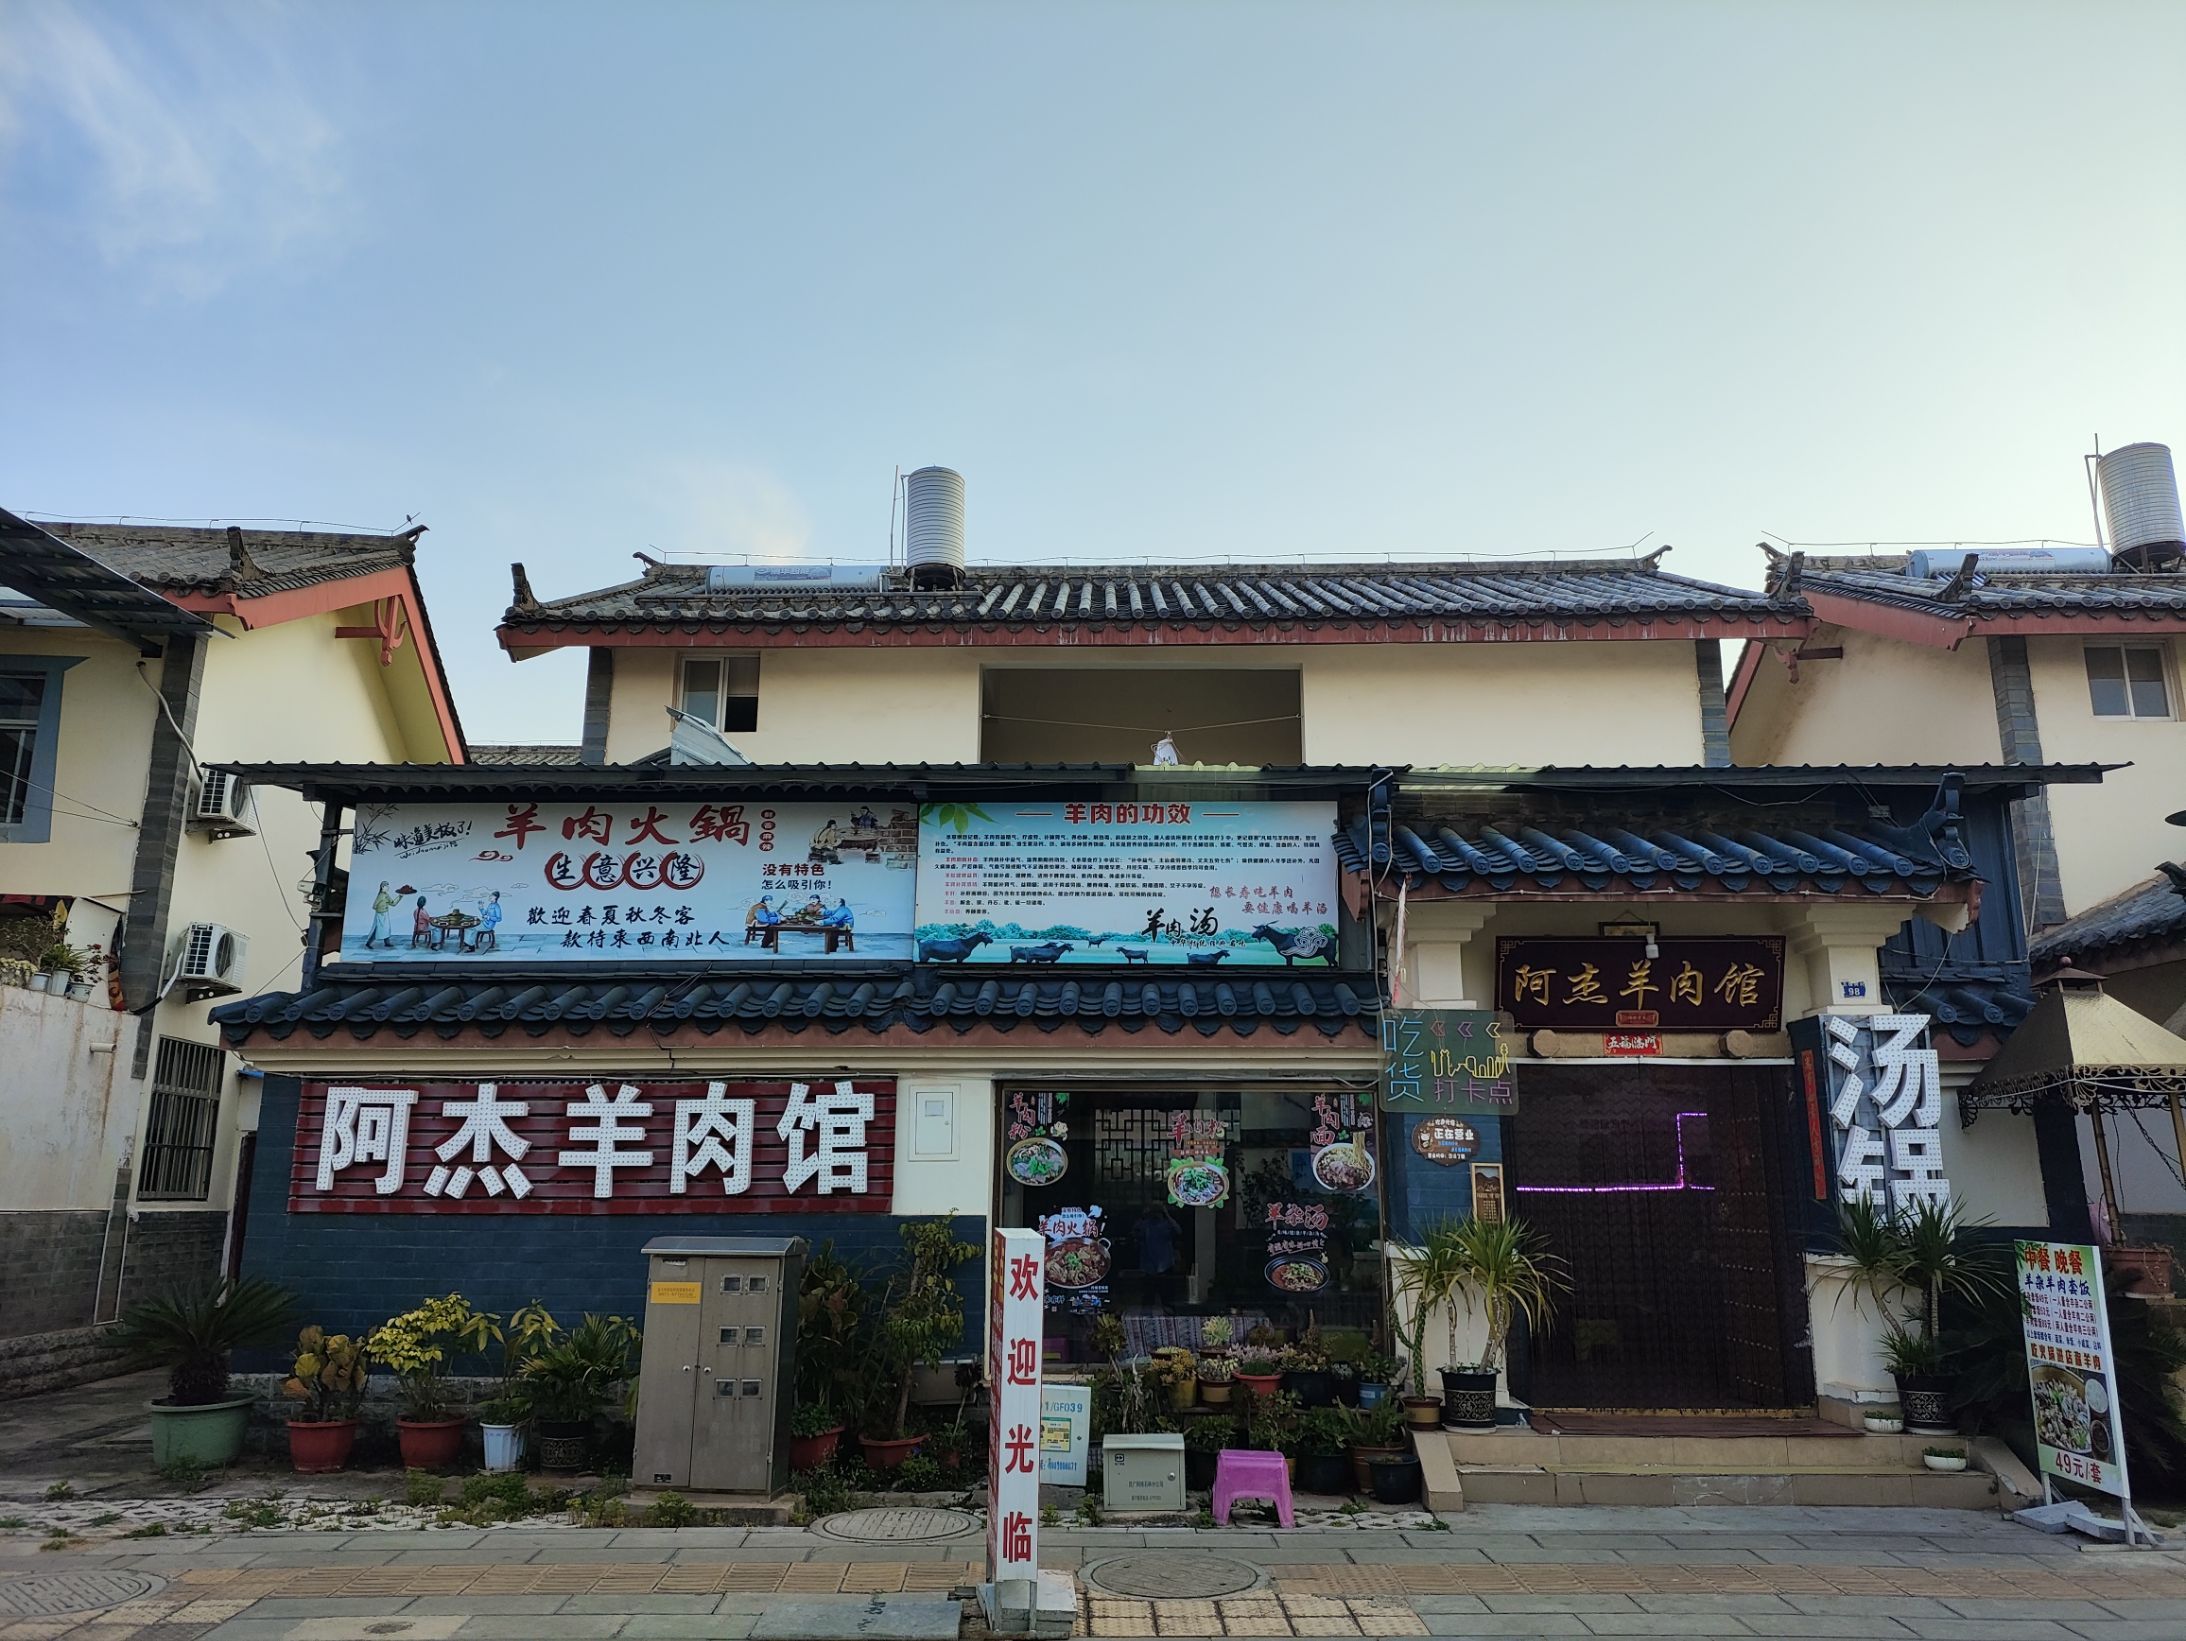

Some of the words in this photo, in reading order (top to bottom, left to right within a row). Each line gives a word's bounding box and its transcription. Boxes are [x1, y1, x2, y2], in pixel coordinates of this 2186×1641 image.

[492, 803, 751, 849] 羊肉火鍋
[1063, 803, 1192, 825] 羊肉的功效
[550, 852, 701, 884] 生意兴隆
[761, 879, 832, 891] 怎么吸引你!
[762, 863, 825, 877] 没有特色
[1140, 906, 1219, 943] 羊肉汤
[1514, 960, 1767, 1009] 阿杰羊肉馆
[1848, 987, 1861, 996] 98
[1382, 1016, 1424, 1103] 吃货
[1432, 1078, 1513, 1104] 打卡点
[1008, 1091, 1036, 1141] 羊肉粉
[1167, 1112, 1229, 1147] 羊肉粉
[1311, 1093, 1340, 1146] 羊肉面
[1826, 1014, 1955, 1243] 汤锅
[315, 1080, 876, 1199] 阿杰羊肉馆
[1434, 1128, 1475, 1140] 正在营业
[2024, 1247, 2051, 1272] 中餐
[2055, 1249, 2083, 1276] 晚餐
[2024, 1272, 2091, 1297] 羊杂羊肉套饭
[1002, 1252, 1040, 1565] 欢迎光临
[2055, 1450, 2102, 1485] 49元/套
